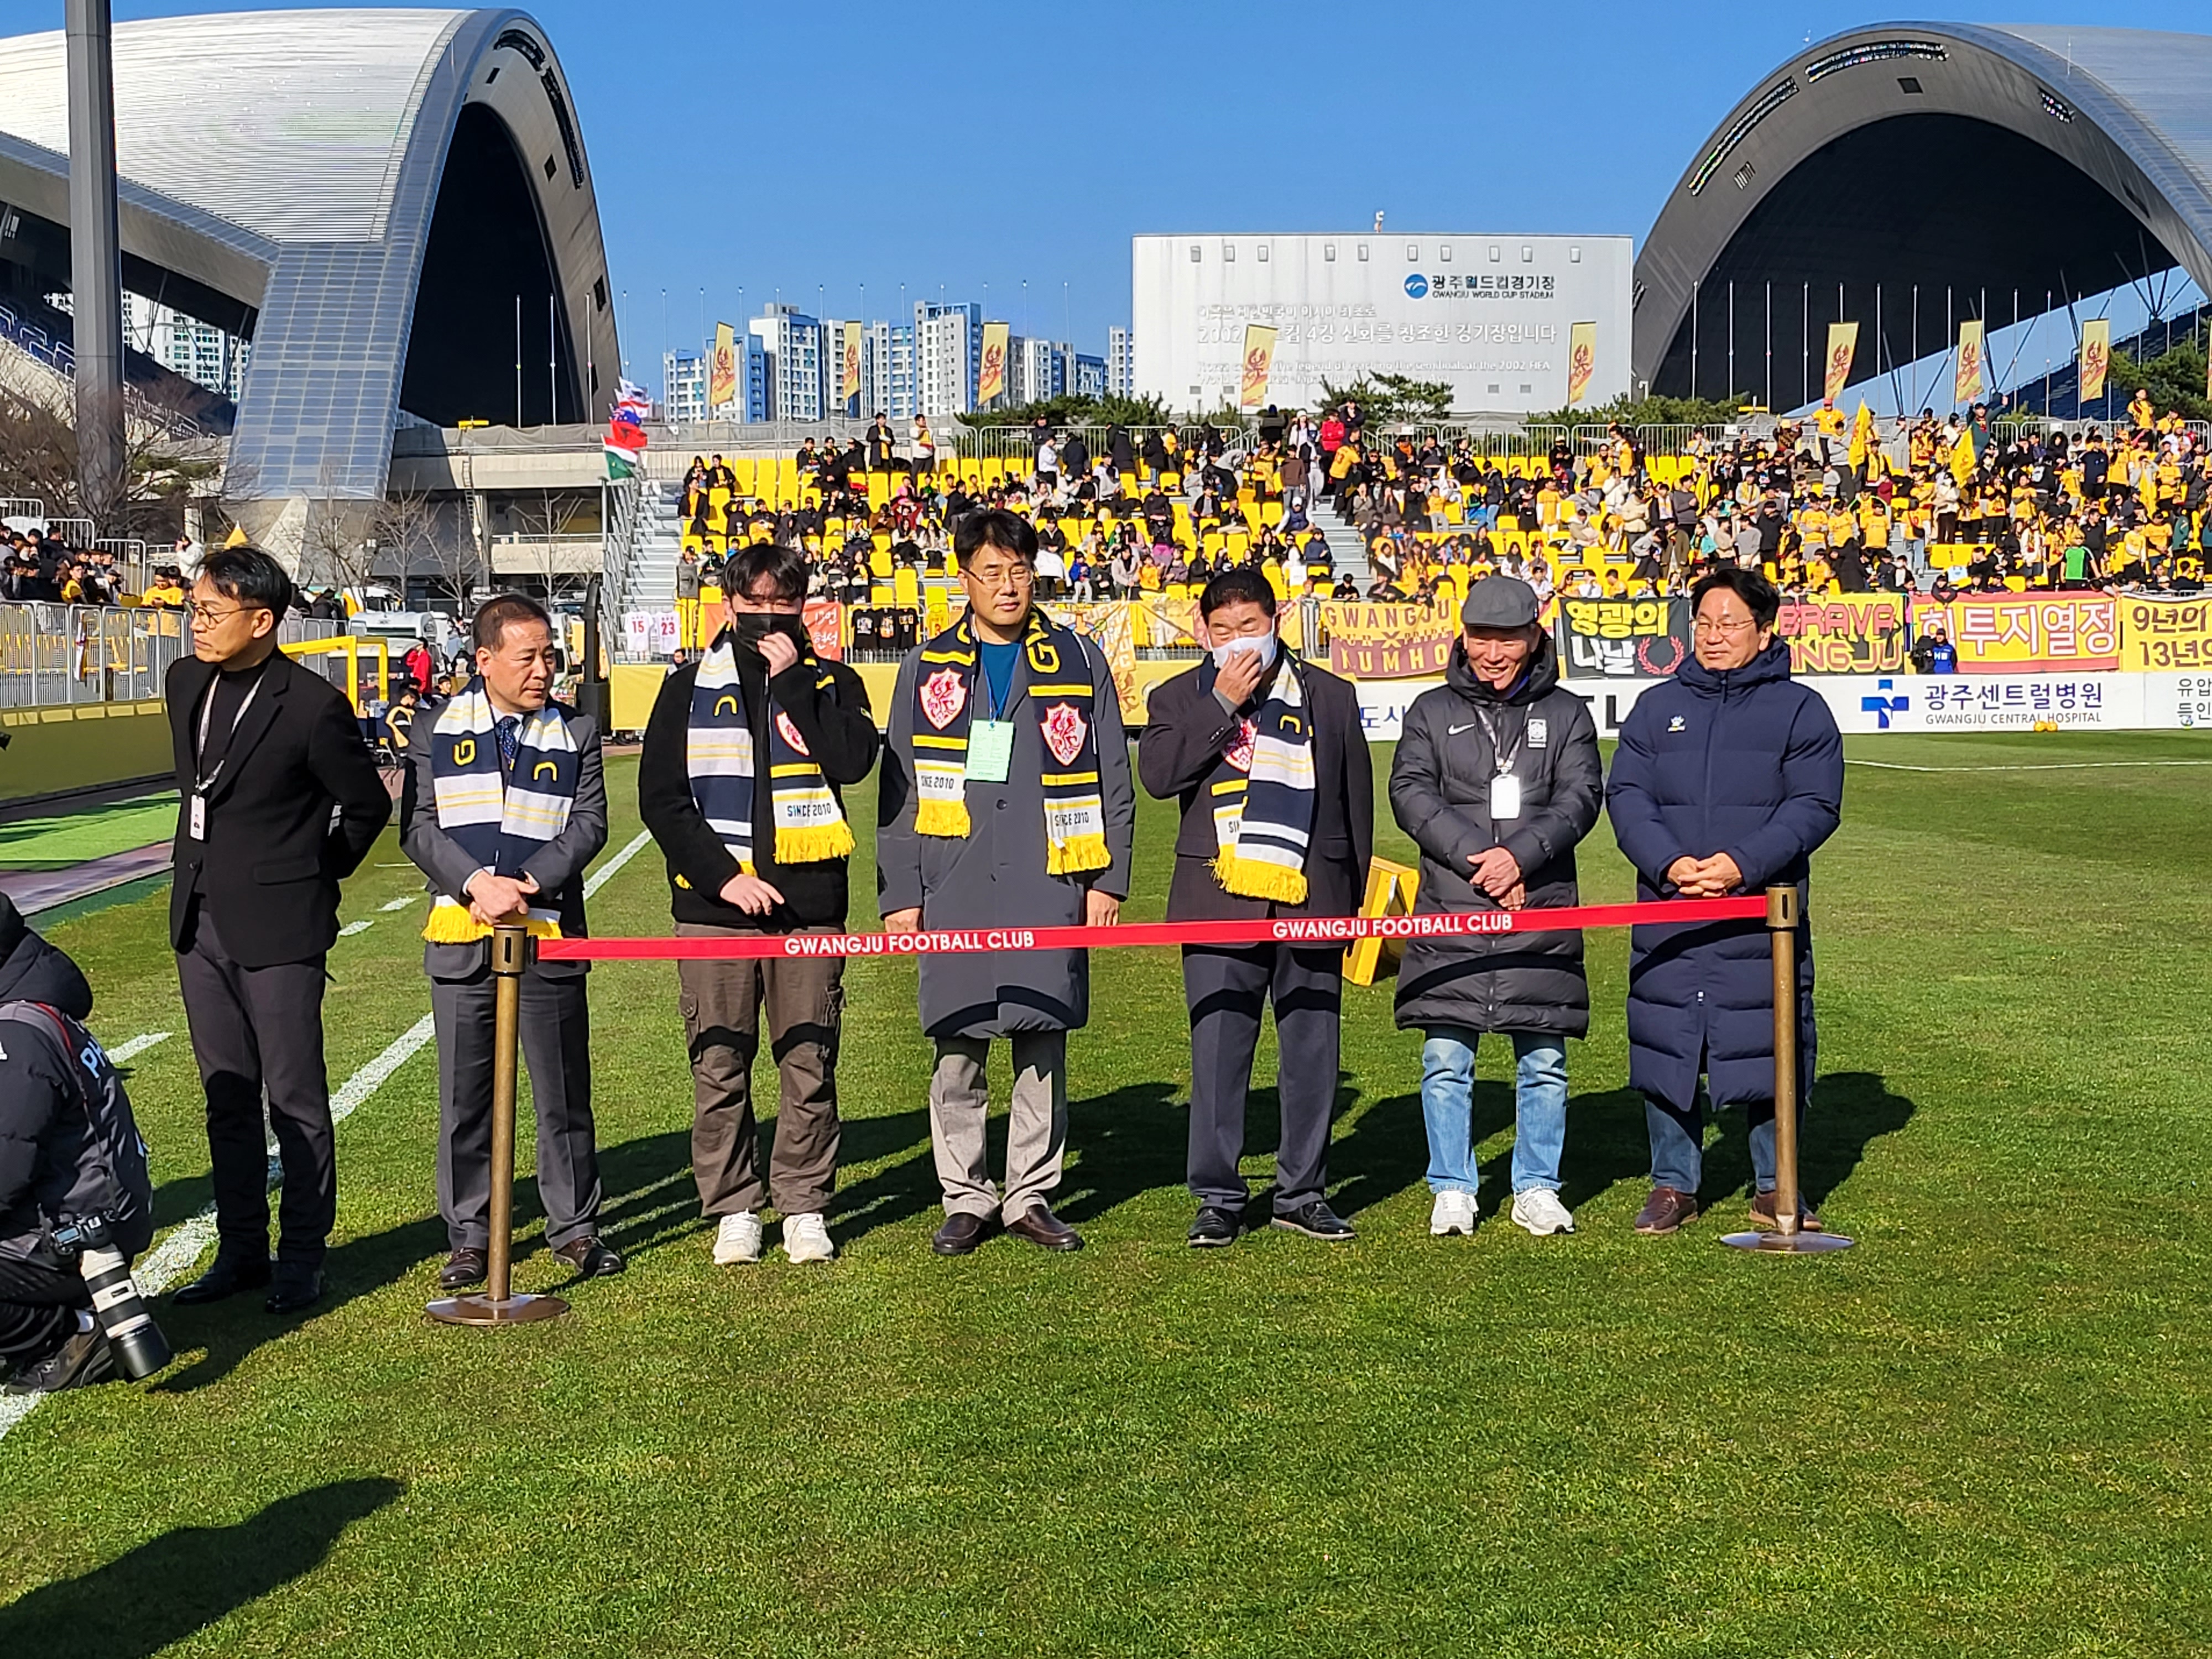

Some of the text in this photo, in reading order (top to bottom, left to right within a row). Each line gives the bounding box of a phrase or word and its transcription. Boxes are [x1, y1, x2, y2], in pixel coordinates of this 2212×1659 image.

[1432, 275, 1554, 290] 광주월드컵경기장
[1473, 290, 1499, 299] WORLD
[1520, 291, 1554, 299] STADIUM
[1306, 324, 1335, 344] 4강
[1342, 323, 1393, 344] 신화를
[1456, 323, 1557, 343] 경기장입니다
[1499, 361, 1526, 371] 2002
[1529, 361, 1552, 371] FIFA
[1325, 599, 1449, 628] GWANGJU
[1566, 601, 1669, 639] 영광의
[2132, 606, 2206, 633] 9년의
[632, 620, 645, 634] 15
[661, 622, 676, 636] 23
[1340, 643, 1449, 673] KUMHO
[1570, 636, 1635, 675] 나날
[1924, 682, 2102, 711] 광주센트럴병원
[1926, 712, 2101, 725] GWANGJU CENTRAL HOSPITAL
[934, 776, 954, 790] 2010
[787, 802, 831, 817] SINCE 2010
[1272, 914, 1513, 938] GWANGJU FOOTBALL CLUB
[784, 930, 1035, 955] GWANGJU FOOTBALL CLUB
